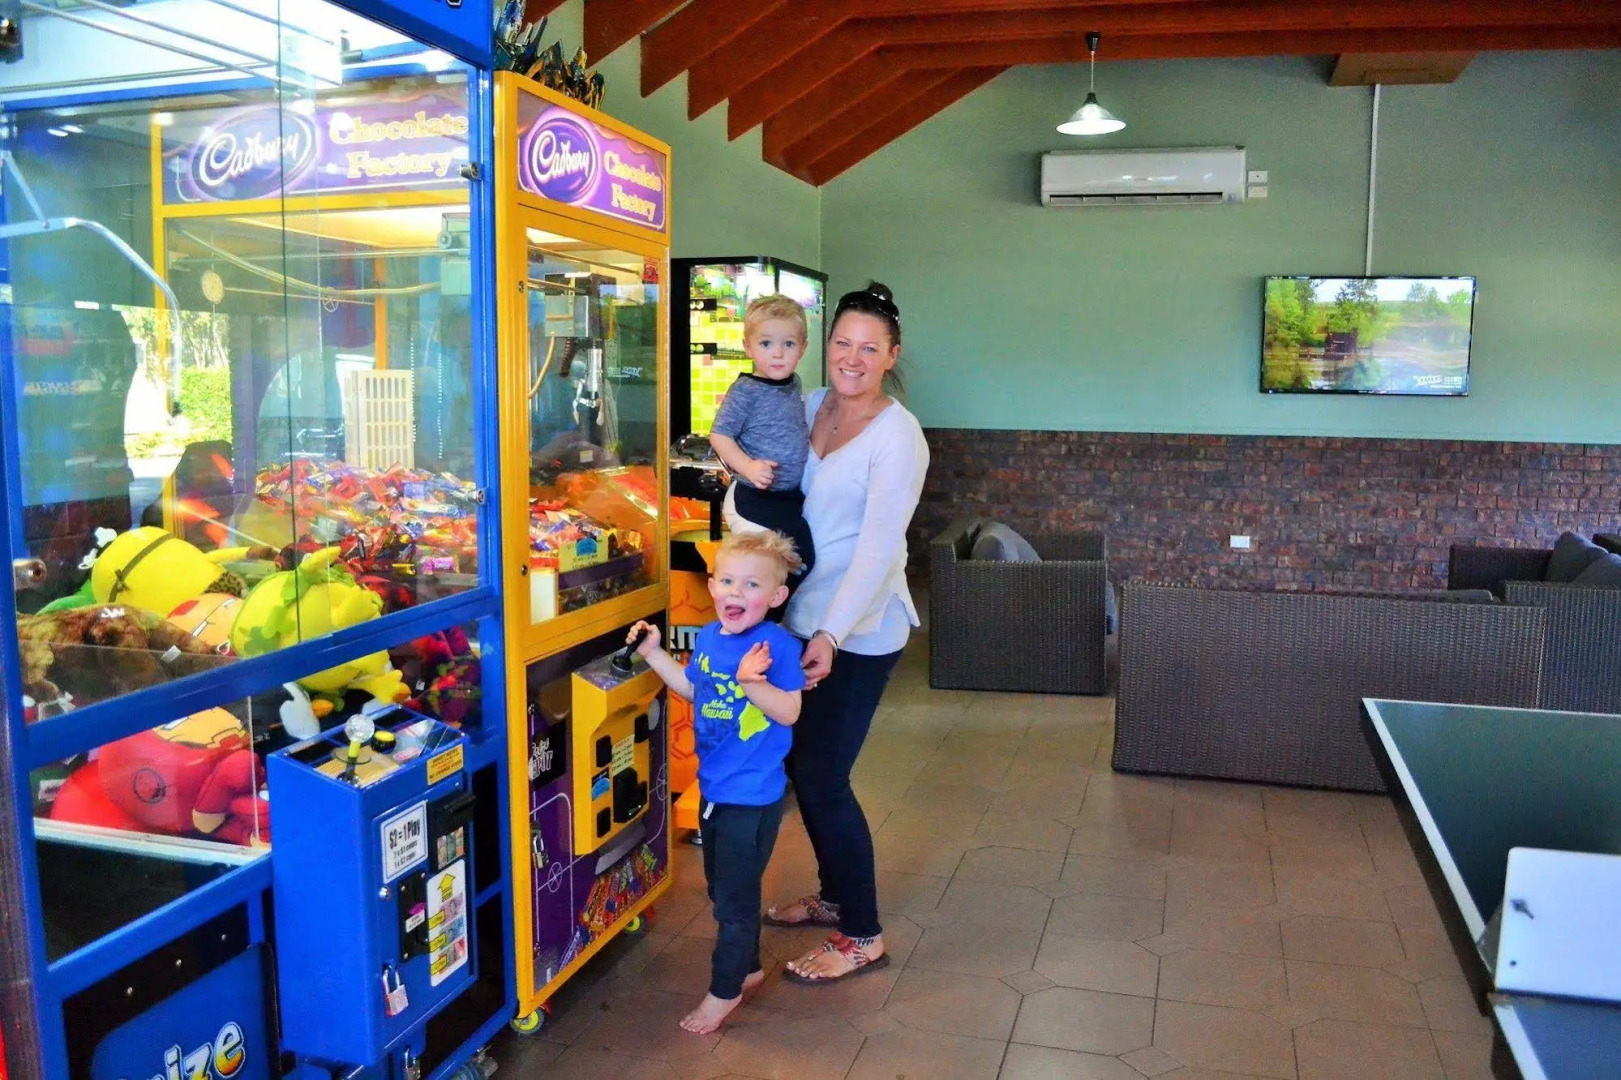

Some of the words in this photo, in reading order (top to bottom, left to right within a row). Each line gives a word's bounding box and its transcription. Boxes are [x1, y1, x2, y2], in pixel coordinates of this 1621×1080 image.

[329, 111, 469, 144] Chocolate
[199, 131, 299, 187] Cadbury
[345, 149, 453, 179] Factory
[532, 130, 590, 184] Cadbury
[407, 819, 420, 839] Play
[117, 1021, 246, 1080] ize
